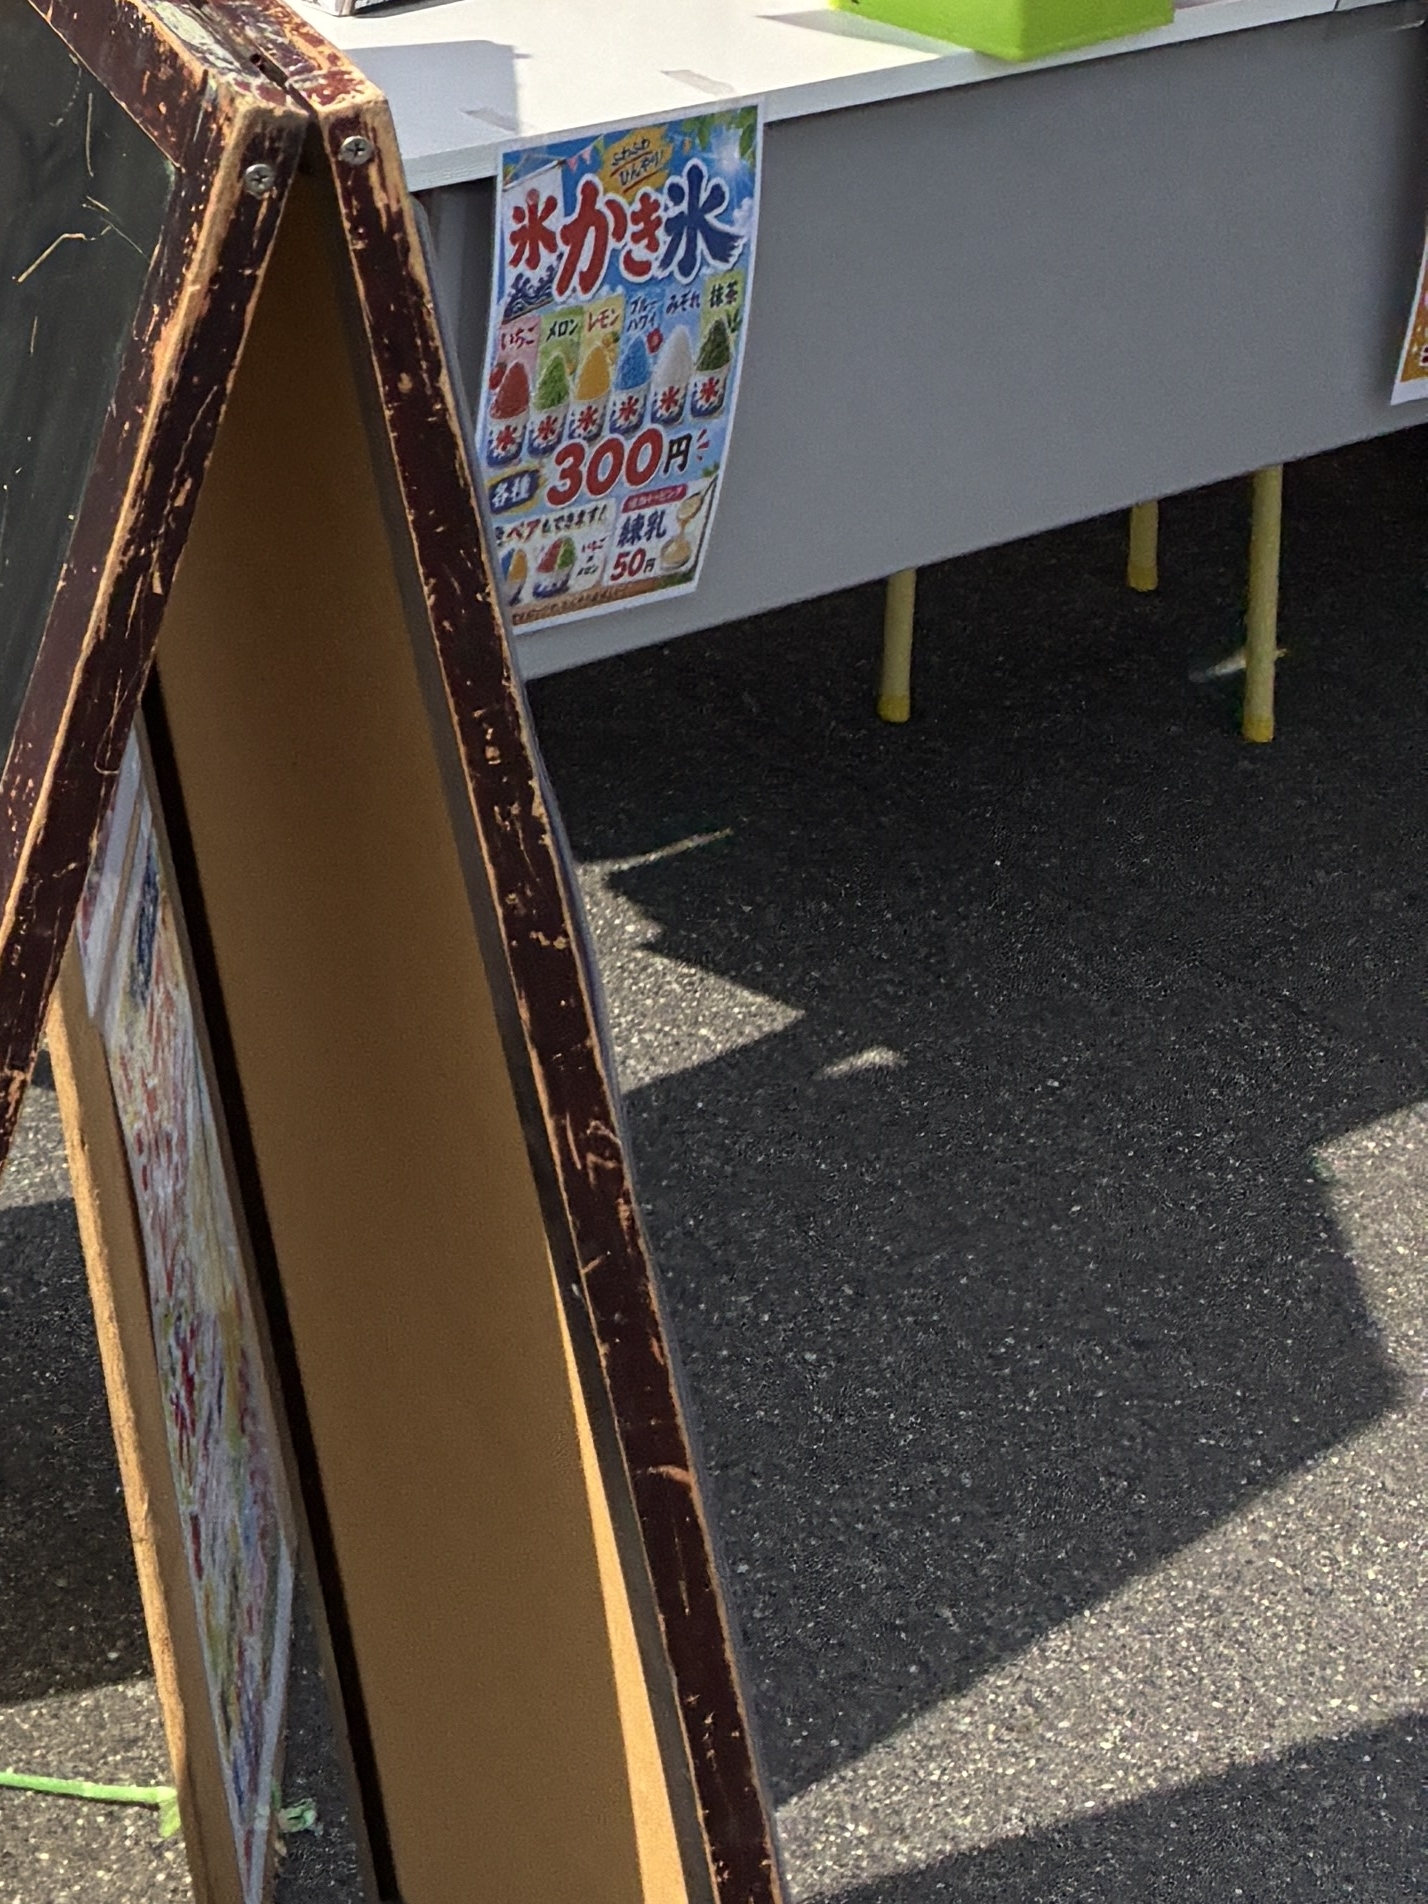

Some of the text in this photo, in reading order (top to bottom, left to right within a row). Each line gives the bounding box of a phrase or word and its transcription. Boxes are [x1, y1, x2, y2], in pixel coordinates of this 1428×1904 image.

[555, 162, 744, 297] かき氷
[665, 290, 701, 315] みぞれ
[708, 280, 739, 309] 抹茶
[545, 318, 579, 342] メロン
[587, 307, 620, 332] レモン
[626, 313, 657, 333] ハワイ
[499, 324, 538, 351] いちご
[546, 427, 693, 507] 300円
[491, 473, 532, 508] 各種
[617, 510, 668, 547] 練乳
[609, 547, 656, 582] 50円
